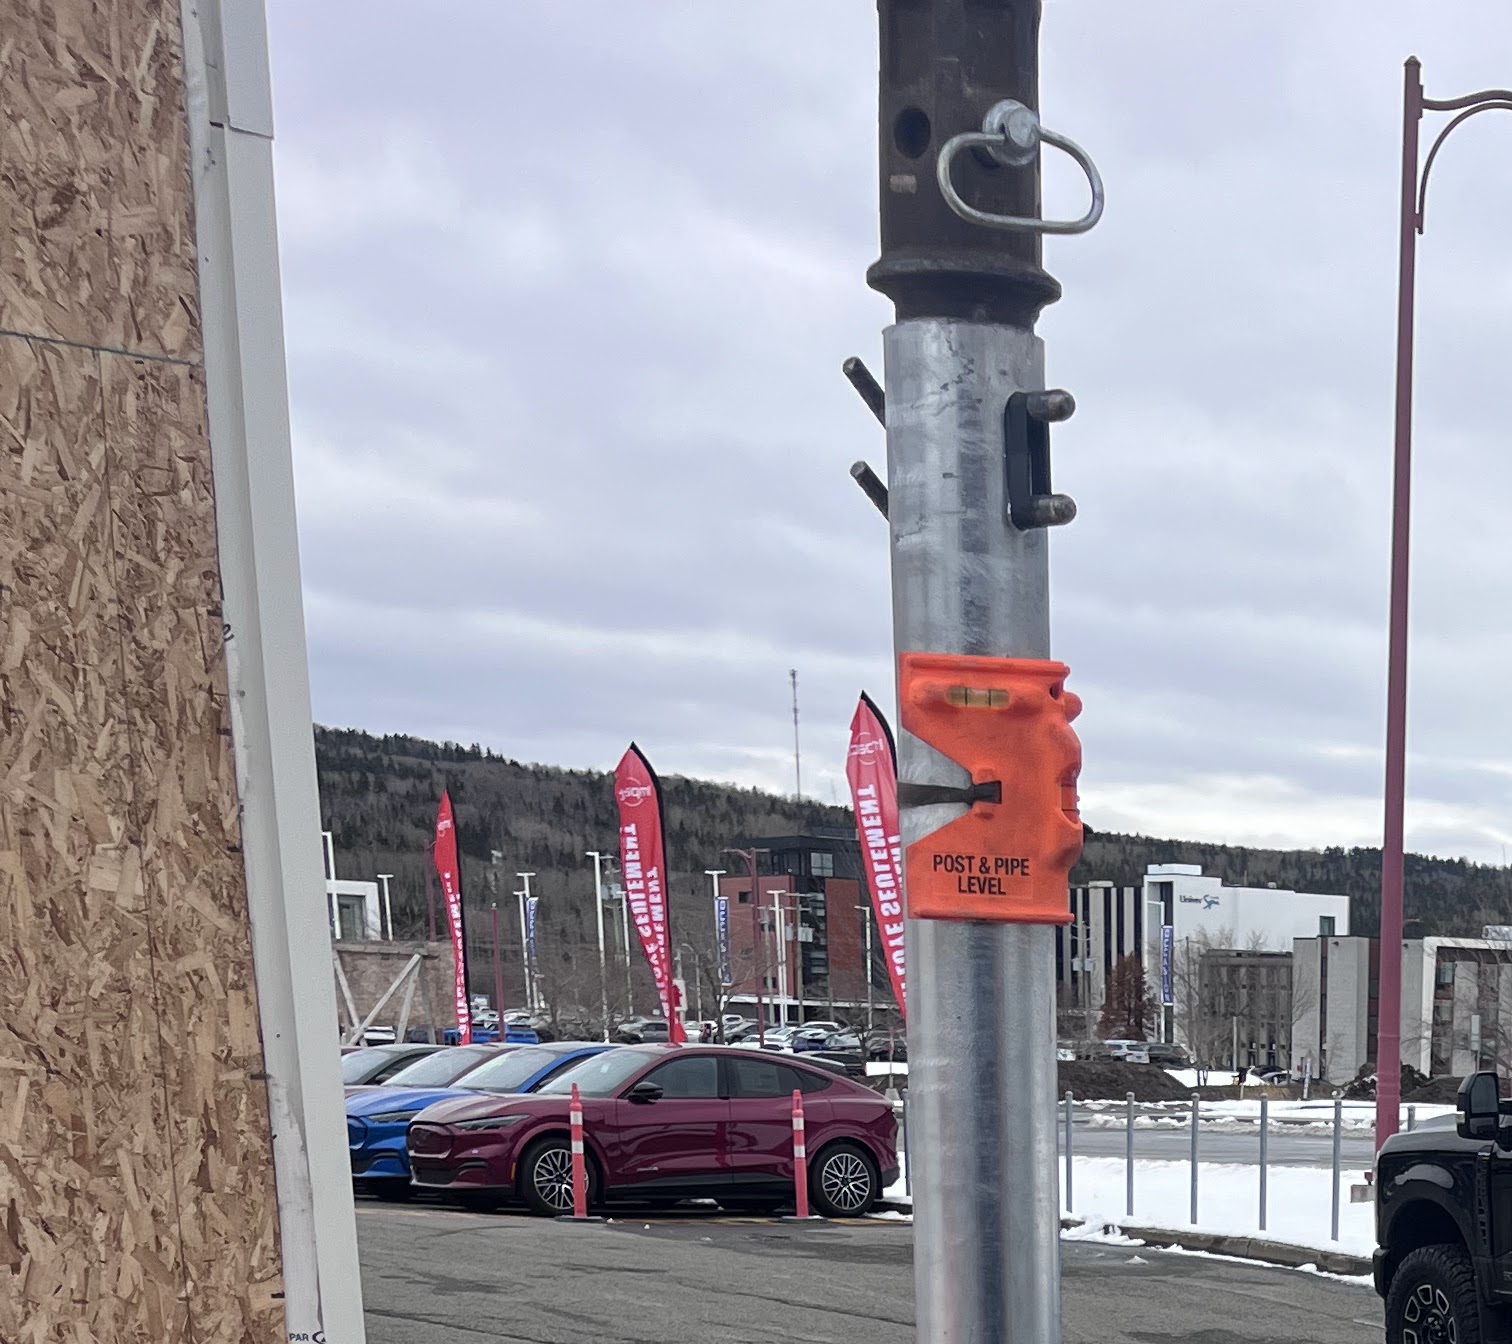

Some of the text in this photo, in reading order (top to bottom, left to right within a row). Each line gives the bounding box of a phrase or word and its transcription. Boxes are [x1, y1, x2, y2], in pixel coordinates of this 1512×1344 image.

[933, 854, 1030, 876] POST & PIPE
[957, 876, 1007, 896] LEVEL
[289, 1332, 309, 1342] PAR
